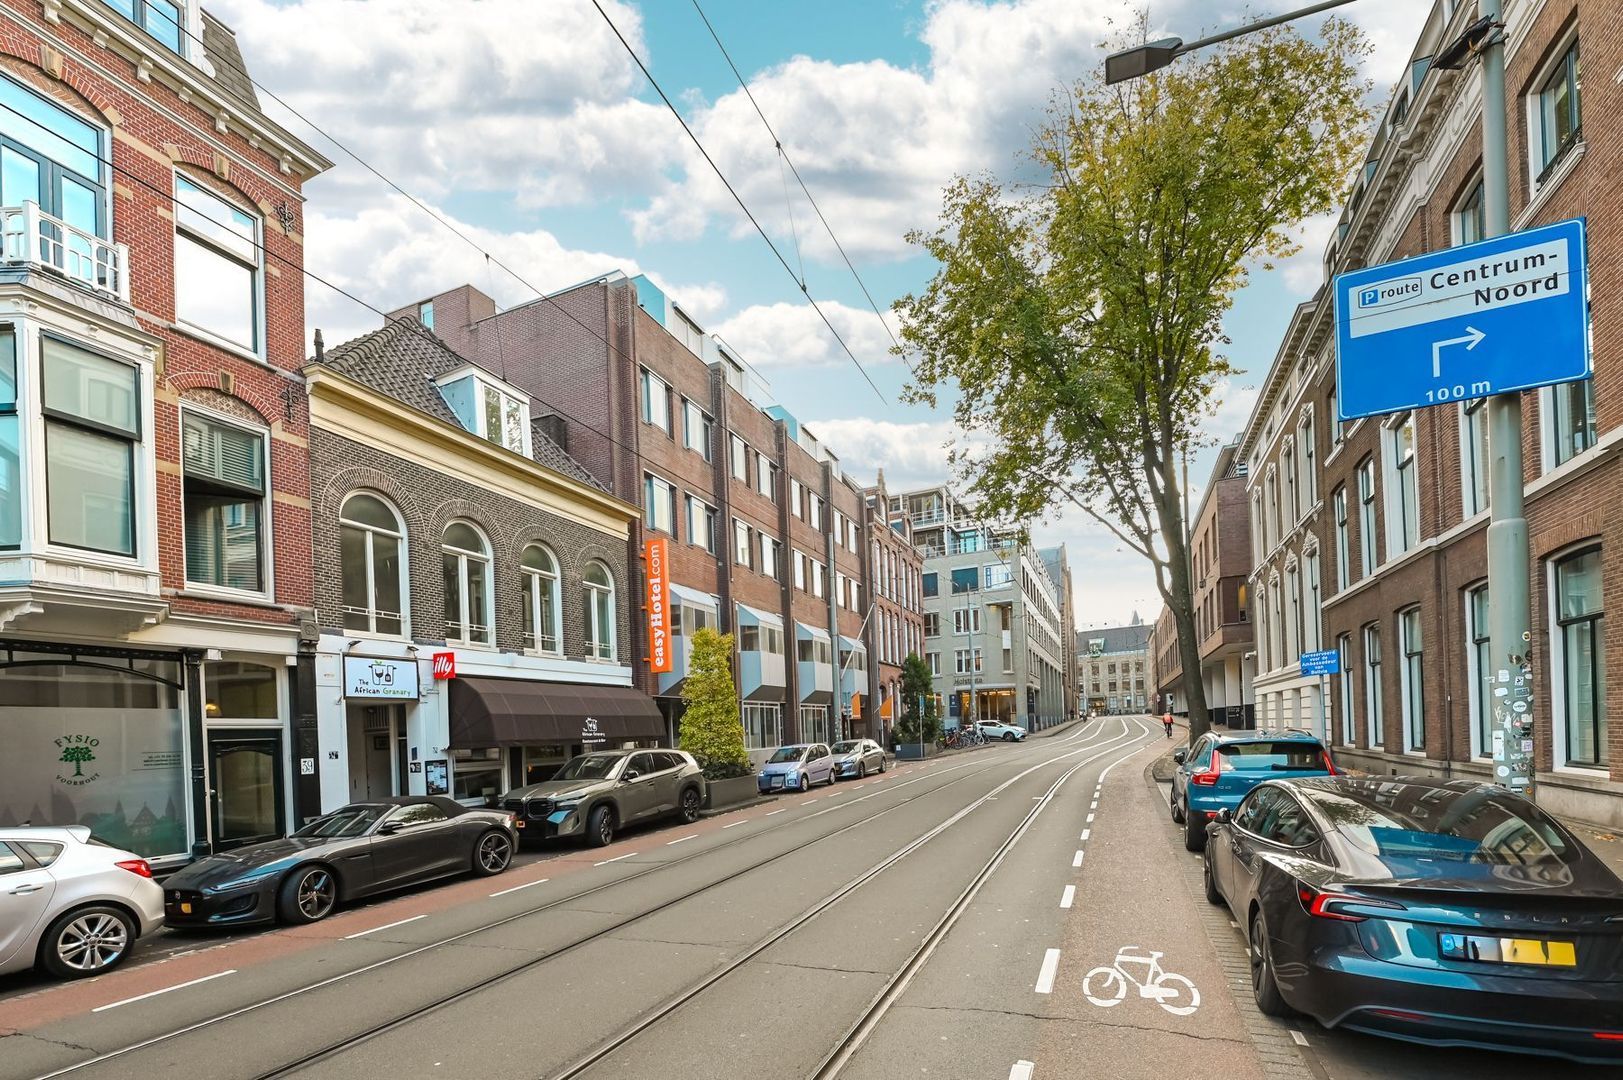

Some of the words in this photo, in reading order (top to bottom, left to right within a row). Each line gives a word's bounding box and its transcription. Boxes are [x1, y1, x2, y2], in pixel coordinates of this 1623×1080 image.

[1365, 292, 1374, 304] P
[1381, 281, 1419, 299] route
[1430, 252, 1559, 290] Centrum-
[1474, 272, 1559, 306] Noord
[1425, 385, 1465, 402] 100
[1472, 380, 1491, 395] m
[650, 544, 665, 667] easyHotel.com
[434, 656, 453, 677] illy
[358, 678, 369, 686] The
[354, 686, 381, 695] African
[382, 687, 411, 697] Granary
[54, 734, 100, 748] FYSIO
[302, 759, 313, 773] 39
[55, 772, 100, 786] VOORHOUT
